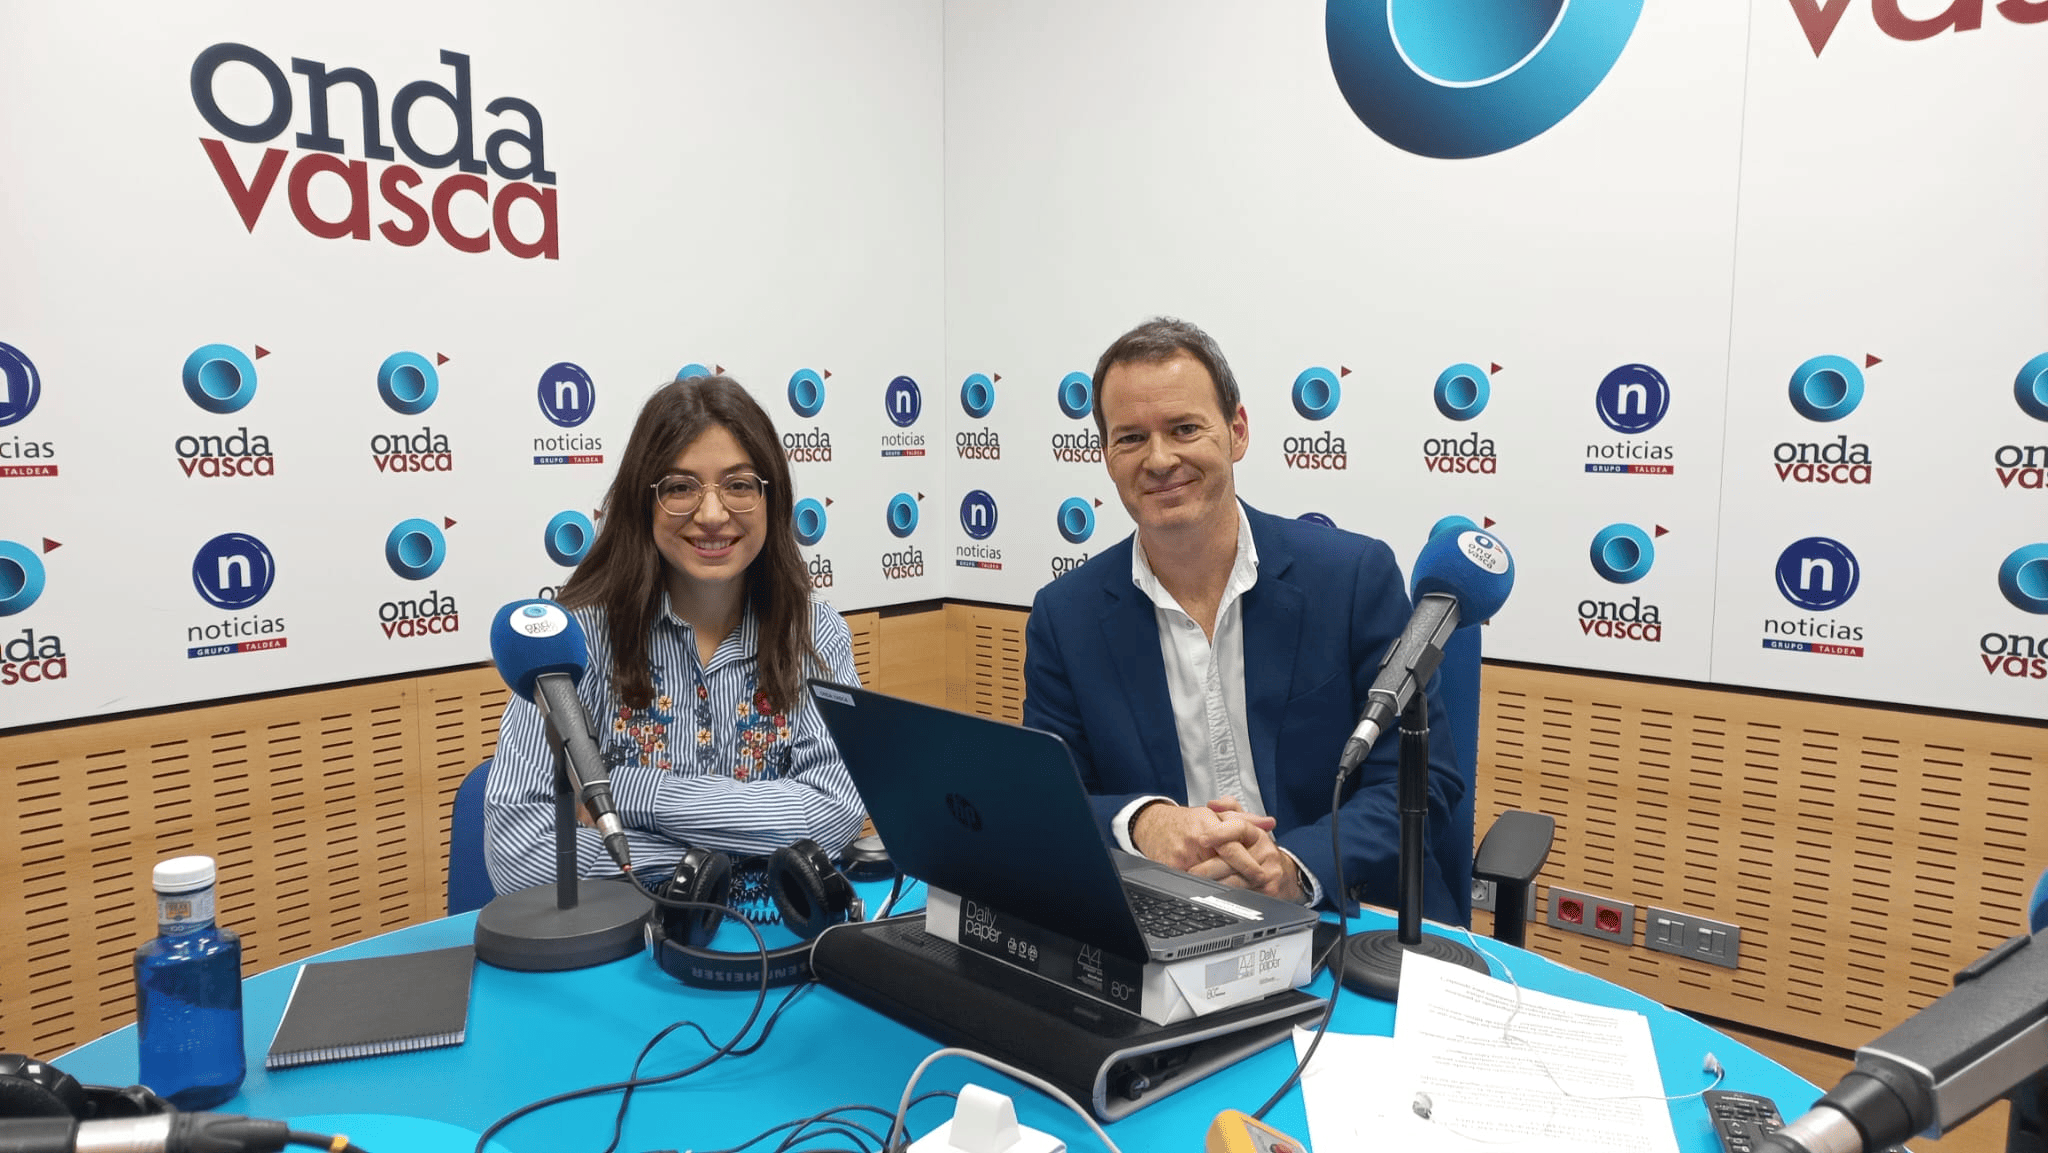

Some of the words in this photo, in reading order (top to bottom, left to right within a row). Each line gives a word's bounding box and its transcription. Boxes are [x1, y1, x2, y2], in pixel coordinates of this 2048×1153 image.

[191, 42, 557, 185] onda
[199, 137, 559, 260] vasca
[0, 436, 54, 459] cias
[175, 427, 273, 458] onda
[371, 427, 452, 455] onda
[534, 433, 602, 451] noticias
[783, 427, 831, 449] onda
[881, 432, 925, 446] noticias
[956, 427, 1001, 449] onda
[1052, 428, 1101, 449] onda
[1284, 431, 1347, 456] onda
[1424, 432, 1497, 458] onda
[373, 450, 453, 473] vasca
[785, 447, 832, 463] vasca
[957, 446, 1001, 461] vasca
[1053, 448, 1102, 463] vasca
[1284, 452, 1347, 471] vasca
[1586, 440, 1674, 460] noticias
[1774, 435, 1872, 465] onda
[1995, 445, 2048, 469] on
[3, 467, 50, 476] TALDEA
[178, 454, 274, 478] vasca
[1424, 454, 1497, 475] vasca
[1635, 465, 1668, 473] TALDEA
[1775, 462, 1873, 485] vasca
[882, 545, 923, 567] onda
[956, 544, 1002, 560] noticias
[1467, 543, 1497, 566] onda
[1467, 548, 1494, 570] vasca
[809, 554, 833, 575] da
[883, 563, 924, 579] vasca
[1052, 553, 1088, 575] ond
[379, 590, 458, 622] onda
[1578, 596, 1662, 626] onda
[188, 615, 285, 641] noticias
[380, 612, 460, 639] vasca
[1579, 618, 1662, 643] vasca
[1764, 617, 1864, 641] noticias
[4, 628, 66, 663] da
[196, 646, 231, 656] GRUPO
[245, 640, 281, 651] TALDEA
[1771, 641, 1804, 650] GRUPO
[1818, 645, 1857, 655] TALDEA
[1980, 632, 2048, 659] on
[2, 657, 68, 686] sca
[1981, 653, 2048, 680] vas
[966, 901, 997, 928] Daily
[965, 919, 1002, 944] paper
[1077, 943, 1102, 970] A4
